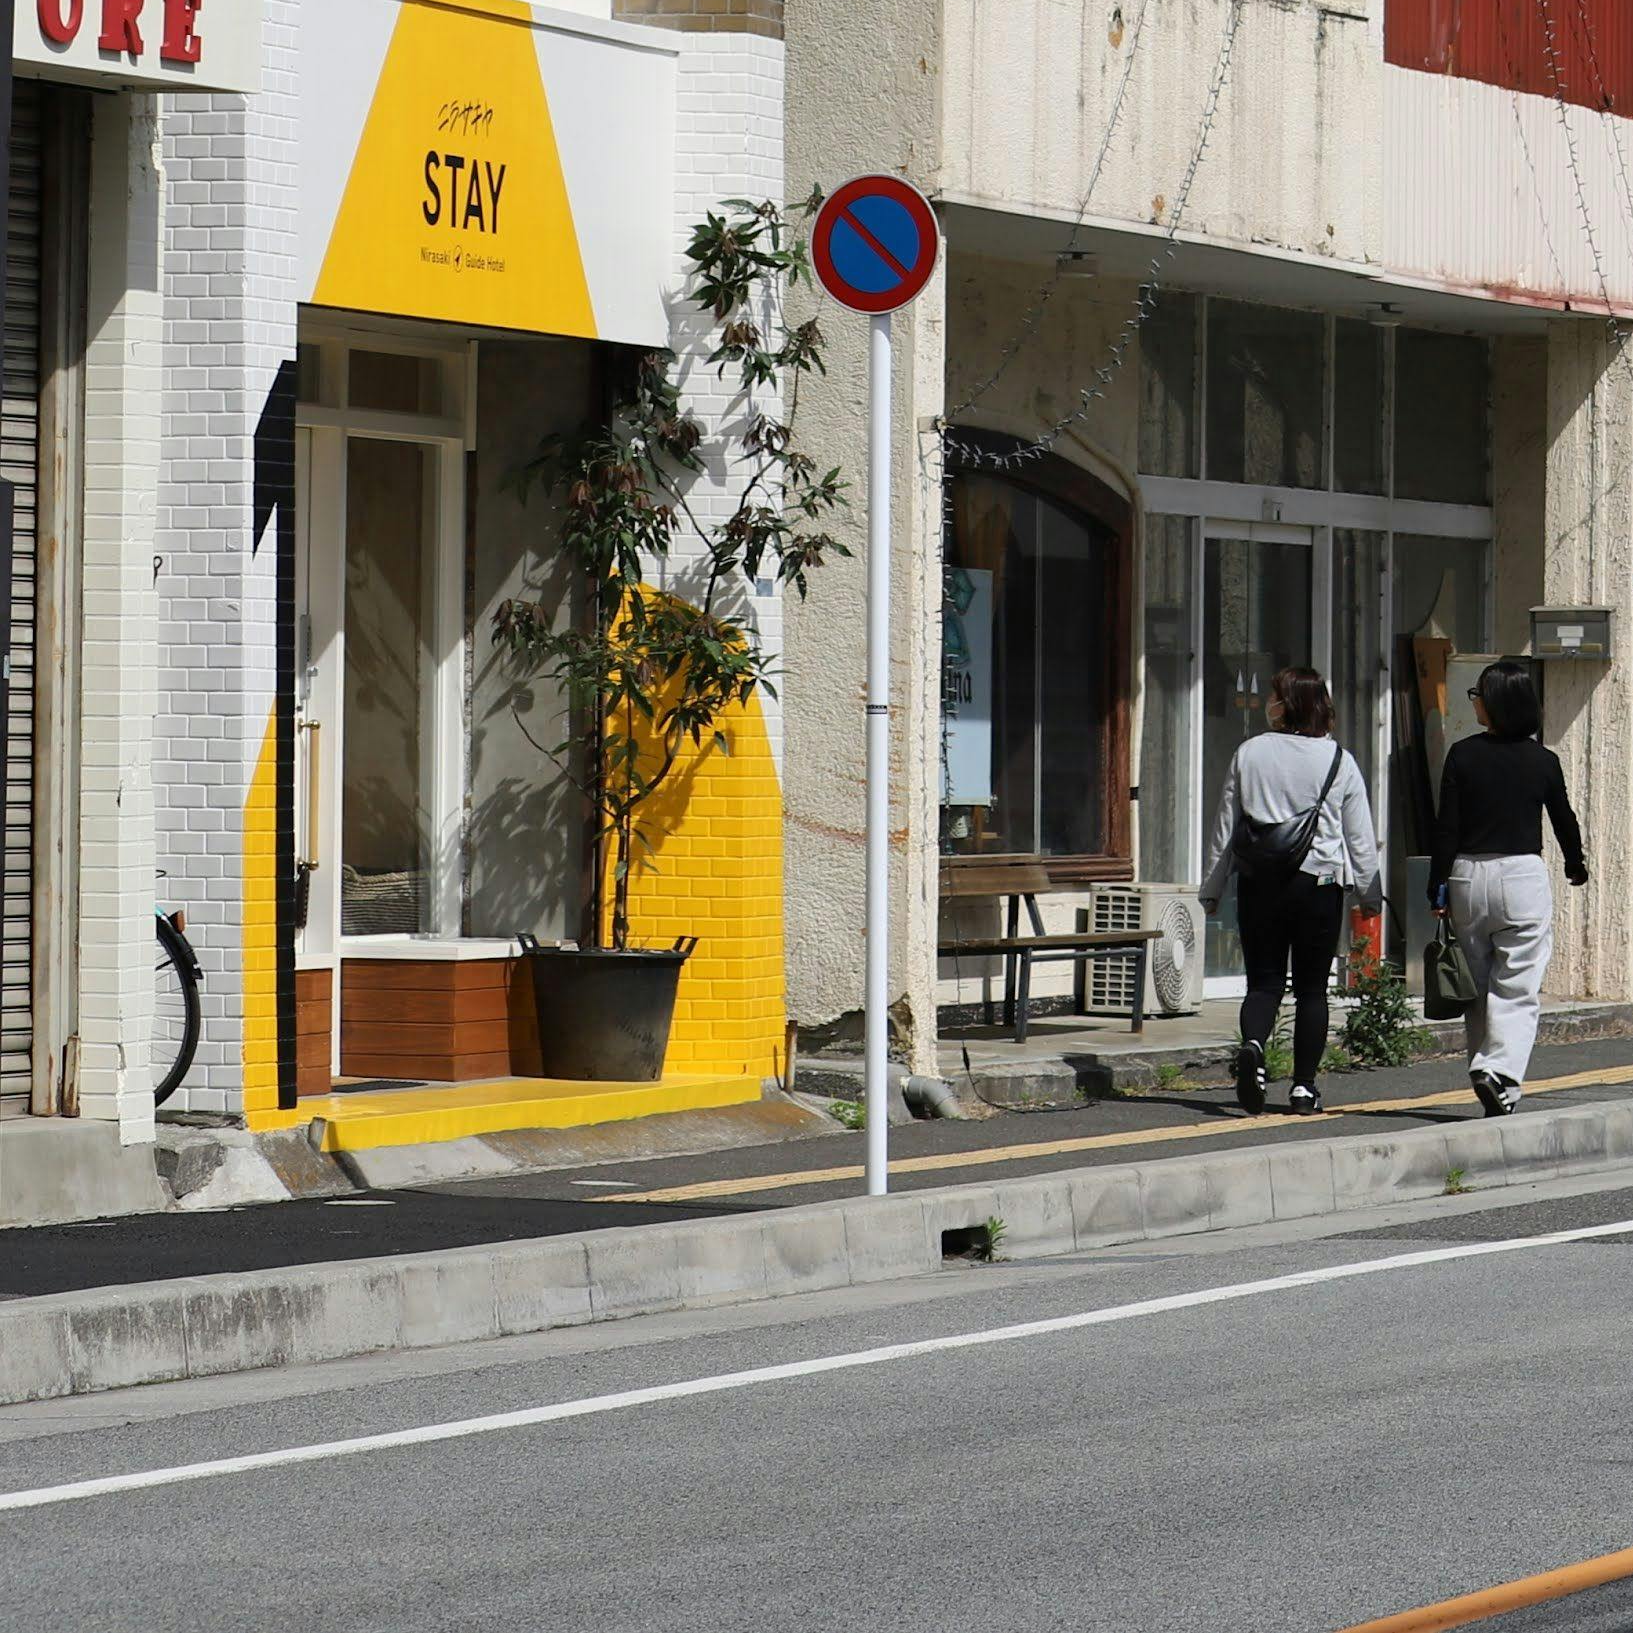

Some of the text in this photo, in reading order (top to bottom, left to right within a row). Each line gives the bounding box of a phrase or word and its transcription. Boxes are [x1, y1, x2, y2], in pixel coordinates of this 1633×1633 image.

[422, 150, 506, 234] STAY
[420, 246, 506, 273] Nirasaki Guide Hotel
